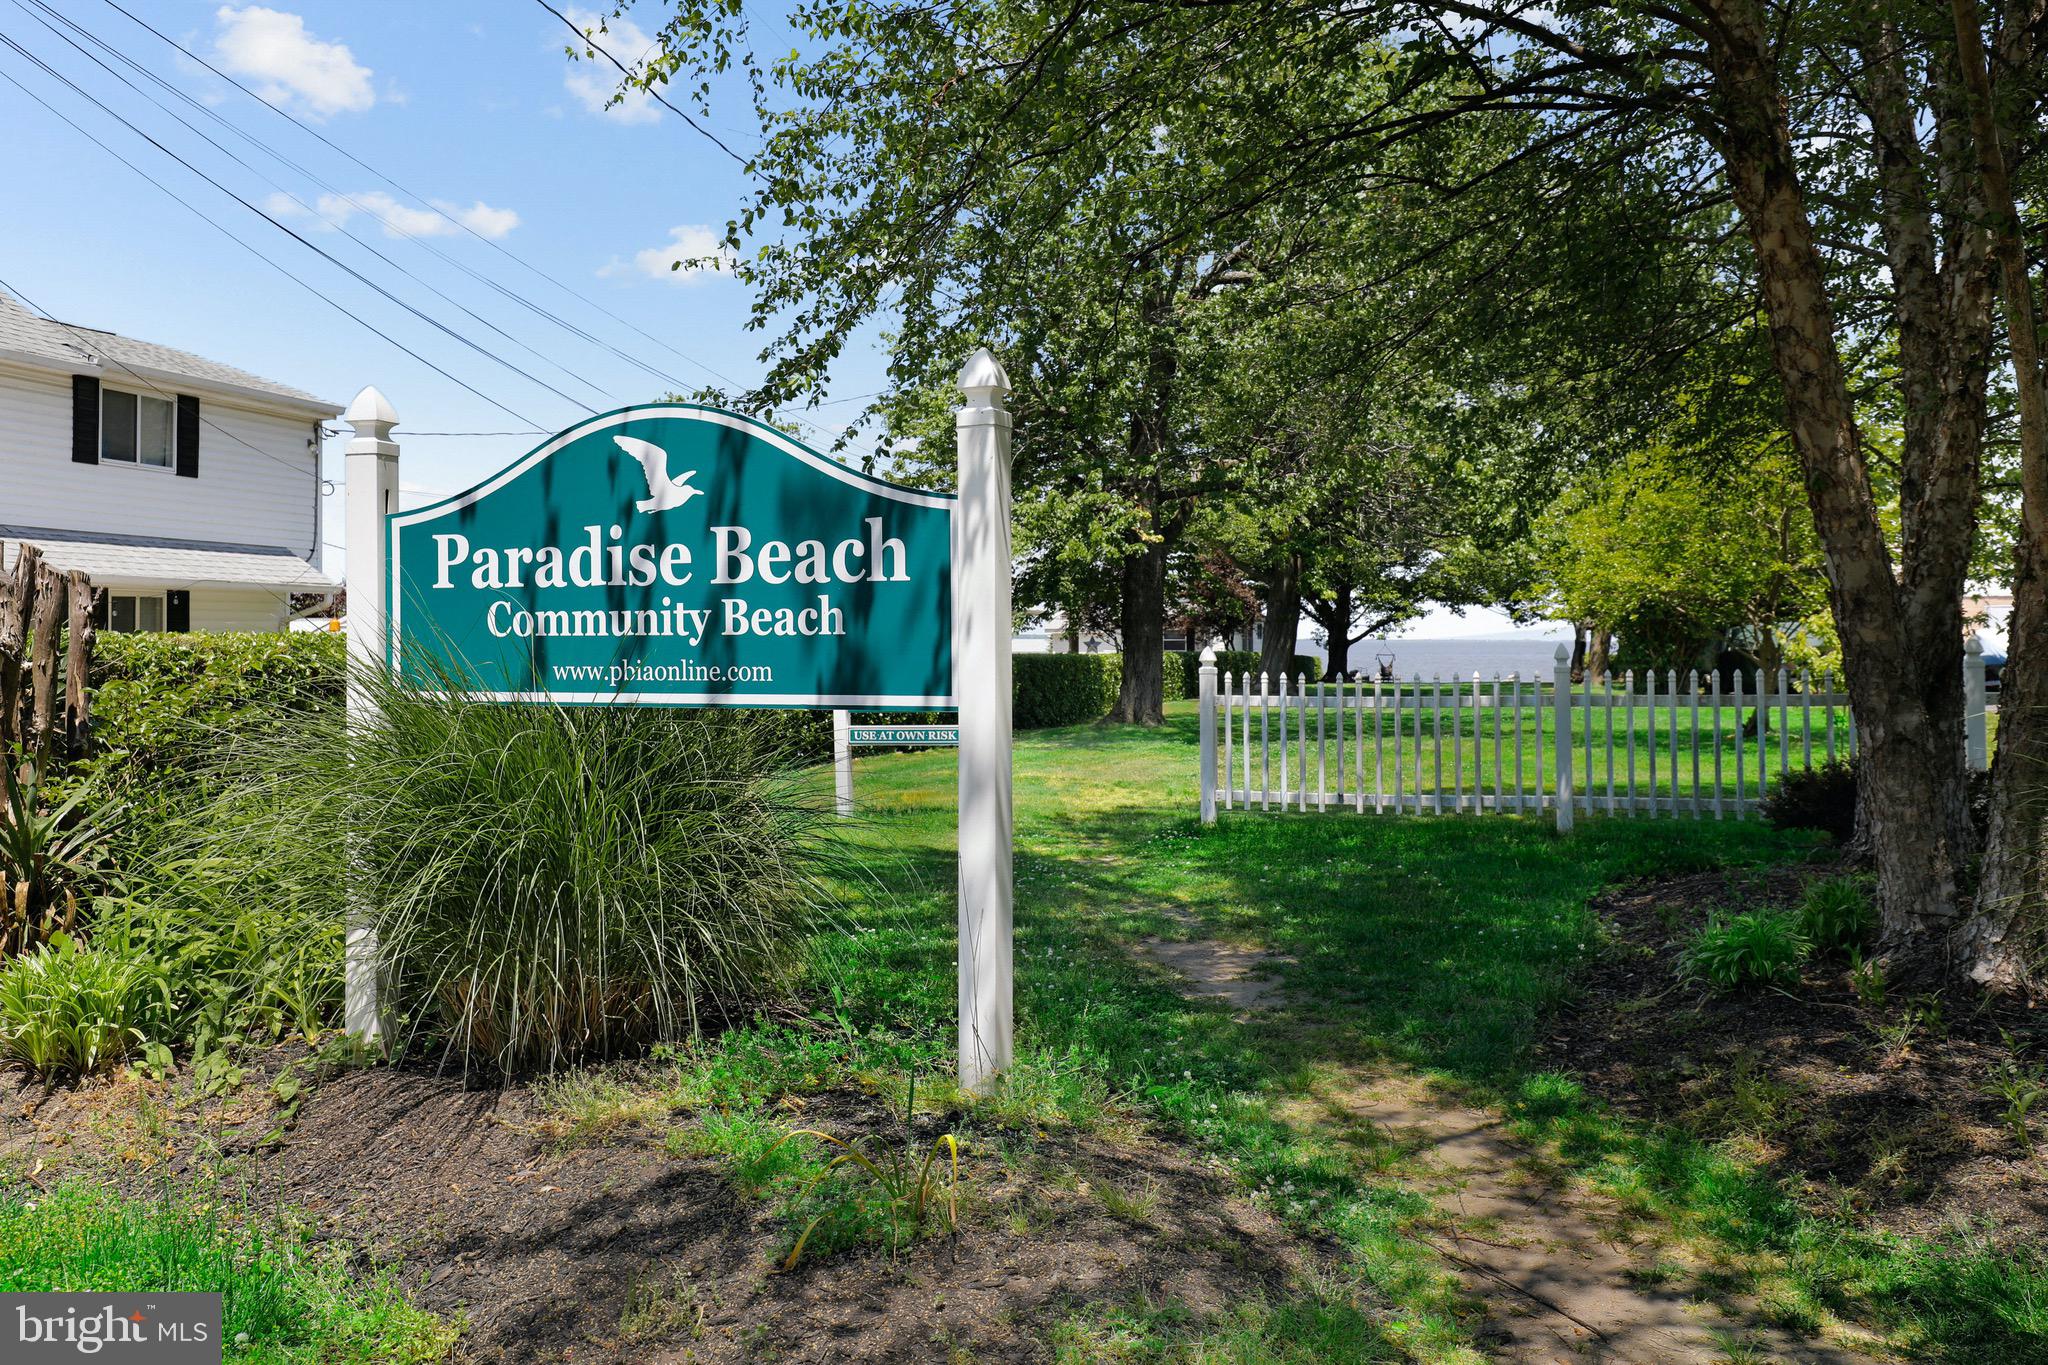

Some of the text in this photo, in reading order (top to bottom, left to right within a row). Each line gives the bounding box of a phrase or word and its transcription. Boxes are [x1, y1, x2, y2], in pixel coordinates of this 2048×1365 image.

[432, 517, 911, 589] Paradise Beach
[487, 594, 846, 646] Community Beach
[553, 659, 773, 686] www.pbiaonline.com
[854, 730, 957, 741] USE AT OWN RISK
